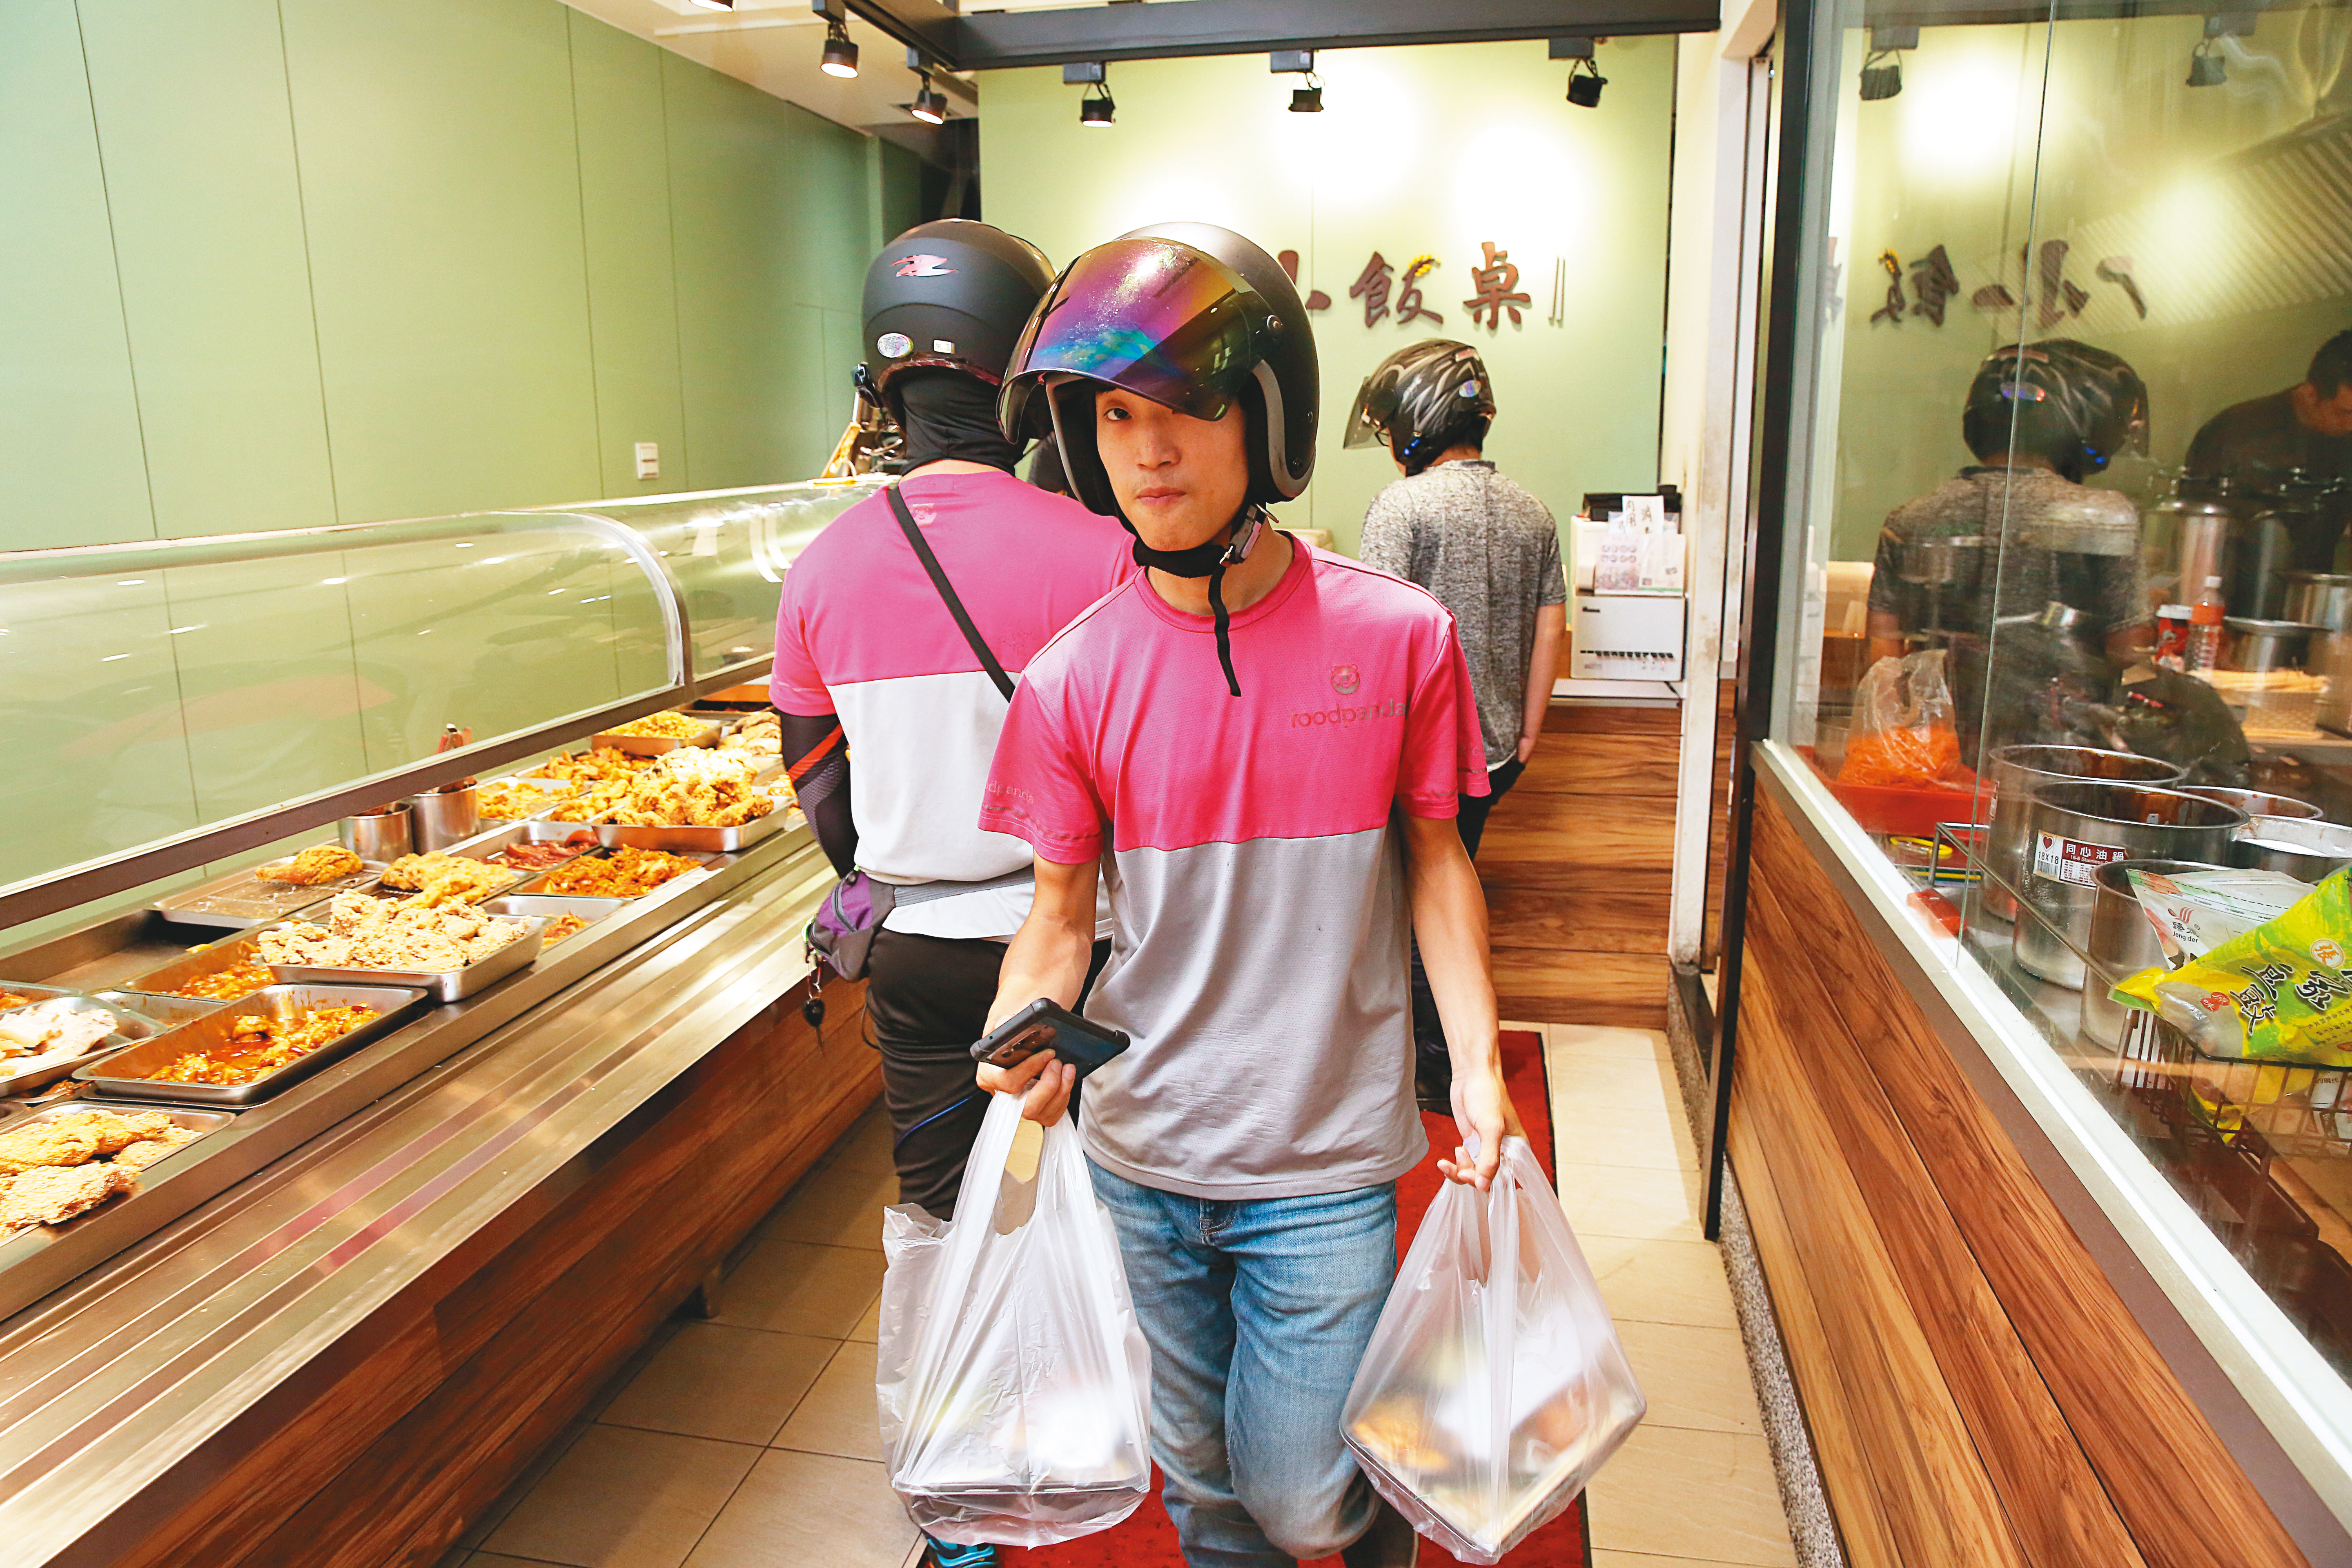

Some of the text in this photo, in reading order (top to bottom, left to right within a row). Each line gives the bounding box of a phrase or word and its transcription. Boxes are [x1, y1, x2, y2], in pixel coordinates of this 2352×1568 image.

[1290, 698, 1405, 728] foodpanda
[2066, 843, 2124, 862] 同心油鍋
[2173, 931, 2186, 941] Jeng
[2203, 994, 2228, 1011] 原味
[2229, 963, 2294, 1036] 豆豉
